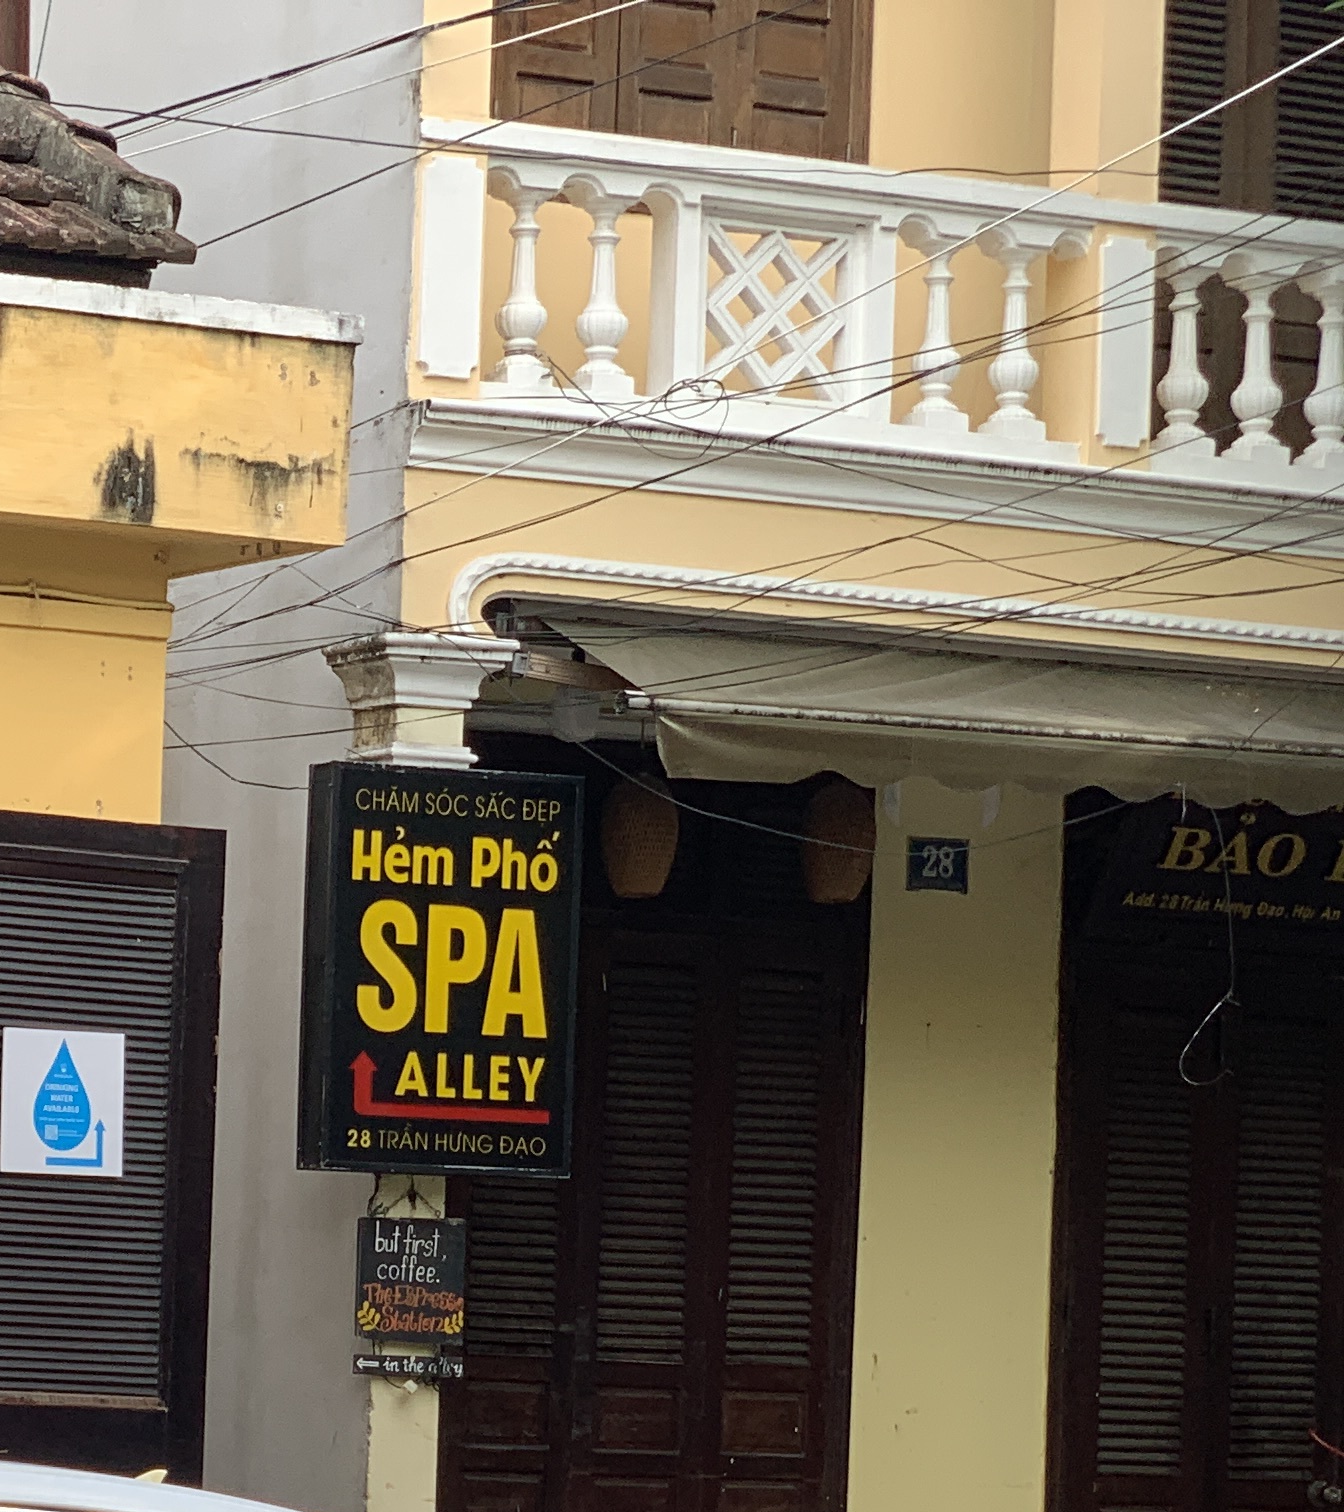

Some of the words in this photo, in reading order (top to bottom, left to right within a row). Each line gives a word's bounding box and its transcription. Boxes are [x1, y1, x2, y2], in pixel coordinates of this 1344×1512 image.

[355, 785, 419, 814] CHĂM
[425, 788, 469, 817] SÓC
[475, 791, 516, 820] SẮC
[522, 799, 561, 828] ĐẸP
[351, 826, 454, 886] Hẻm
[470, 831, 561, 892] Phố
[922, 845, 954, 879] 28
[1156, 811, 1306, 878] BẢO
[356, 899, 548, 1039] SPA
[394, 1051, 545, 1103] ALLEY
[347, 1129, 372, 1149] 28
[377, 1122, 429, 1151] TRẦN
[434, 1131, 494, 1154] HƯNG
[499, 1135, 547, 1160] ĐẠO
[375, 1220, 401, 1253] but
[377, 1255, 440, 1284] coffee.
[383, 1356, 399, 1372] in
[403, 1355, 424, 1373] the
